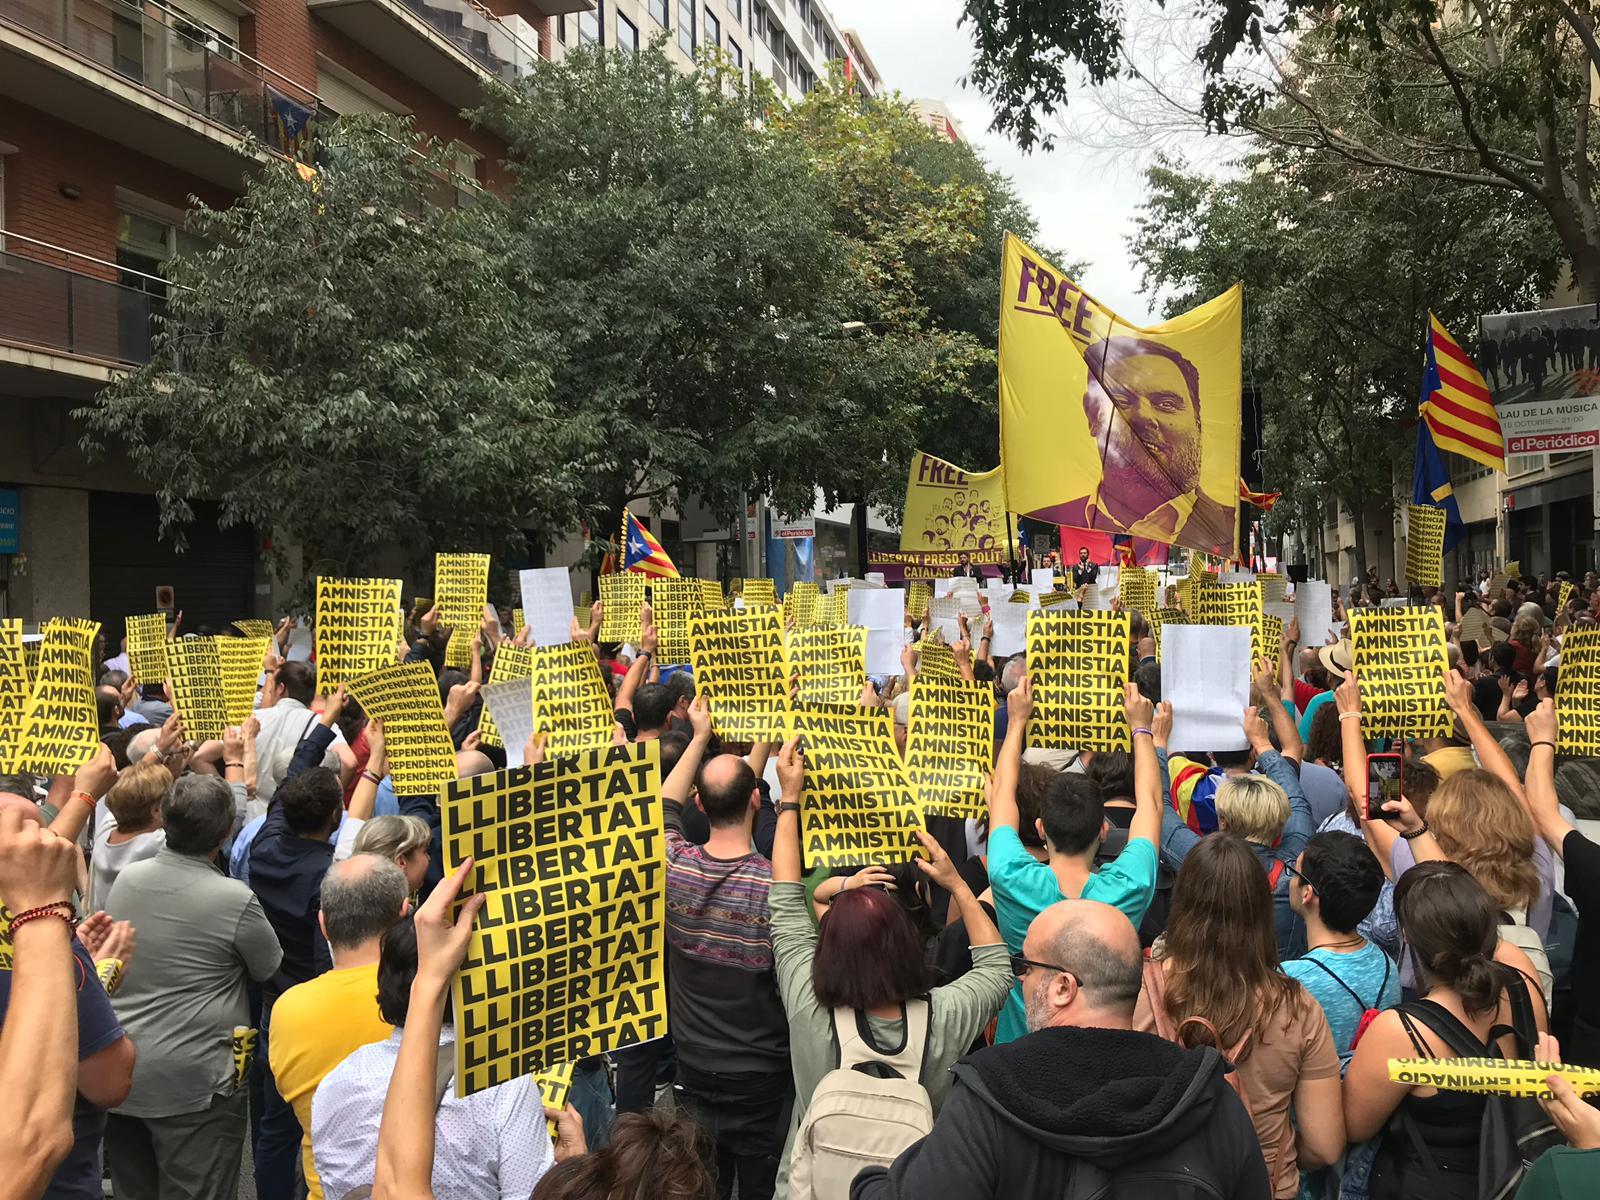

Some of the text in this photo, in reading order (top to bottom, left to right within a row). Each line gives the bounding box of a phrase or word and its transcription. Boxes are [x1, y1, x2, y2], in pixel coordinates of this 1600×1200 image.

[1017, 255, 1098, 337] FREE
[1523, 409, 1537, 417] DE
[1557, 403, 1598, 414] MÚSICA
[1514, 418, 1553, 427] OCTUBRE
[1512, 435, 1595, 451] el Periódico
[924, 554, 961, 564] PRESO
[970, 551, 1000, 563] POLÍT
[320, 587, 396, 599] AMNISTIA
[654, 584, 702, 592] LLIBERTAT
[1200, 590, 1258, 602] AMNISTIA
[654, 593, 704, 601] LLIBERTAT
[320, 601, 395, 613] AMNISTIA
[654, 603, 705, 611] LLIBERTAT
[1200, 601, 1259, 614] AMNISTIA
[319, 615, 394, 627] AMNISTIA
[691, 617, 780, 637] AMNISTIA
[1200, 614, 1259, 625] AMNISTIA
[1355, 618, 1440, 633] AMNISTIA
[319, 629, 392, 641] AMNISTIA
[1030, 622, 1126, 638] AMNISTIA
[44, 630, 90, 650] AMNISTIA
[694, 633, 782, 652] AMNISTIA
[790, 631, 862, 649] AMNISTIA
[1030, 639, 1125, 656] AMNISTIA
[1355, 634, 1442, 649] AMNISTIA
[1563, 634, 1600, 650] AMNIS
[41, 647, 89, 669] AMNISTIA
[166, 644, 217, 656] LLIBERTAT
[320, 644, 391, 655] AMNISTIA
[789, 645, 861, 662] AMNISTIA
[1355, 649, 1444, 665] AMNISTIA
[1561, 649, 1600, 666] AMNIS
[168, 655, 220, 666] LLIBERTAT
[320, 658, 390, 670] AMNISTIA
[536, 651, 594, 670] AMNISTIA
[696, 650, 783, 668] AMNISTIA
[1030, 656, 1125, 673] AMNISTIA
[170, 666, 221, 678] LLIBERTAT
[536, 666, 600, 686] AMNISTIA
[698, 666, 785, 683] AMNISTIA
[789, 660, 863, 677] AMNISTIA
[1357, 665, 1443, 681] AMNISTIA
[172, 677, 222, 688] LLIBERTAT
[349, 666, 431, 690] INDEPENDÈNCIA
[1032, 673, 1124, 689] AMNISTIA
[174, 688, 223, 699] LLIBERTAT
[355, 676, 434, 698] INDEPENDÈNCIA
[536, 681, 606, 701] AMNISTIA
[701, 682, 786, 698] AMNISTIA
[1359, 681, 1446, 697] AMNISTIA
[176, 699, 226, 710] LLIBERTAT
[361, 688, 438, 706] INDEPENDÈNCIA
[912, 687, 991, 707] AMNISTIA
[1032, 689, 1124, 707] AMNISTIA
[1361, 698, 1450, 713] AMNISTIA
[31, 704, 98, 725] AMNISTI
[368, 699, 441, 715] INDEPENDÈNCIA
[537, 697, 610, 717] AMNISTIA
[911, 705, 991, 725] AMNISTIA
[1029, 706, 1127, 724] AMNISTIA
[385, 722, 448, 733] DEPENDÈNCIA
[538, 713, 615, 733] AMNISTIA
[712, 715, 786, 729] MNISTIA
[794, 716, 890, 738] AMNISTIA
[1360, 714, 1450, 727] AMNISTIA
[26, 723, 99, 743] AMNISTI
[385, 734, 450, 746] DEPENDÈNCIA
[911, 721, 990, 742] AMNISTIA
[1030, 723, 1127, 740] AMNISTIA
[21, 741, 97, 761] AMNISTI
[385, 746, 453, 757] DEPENDÈNCIA
[797, 733, 895, 755] AMNISTIA
[910, 737, 989, 759] AMNISTIA
[388, 756, 454, 769] DEPENDÈNCIA
[447, 742, 647, 802] LLIBERTAT
[909, 771, 984, 790] AMNISTI
[802, 771, 909, 792] AMNISTIA
[449, 763, 654, 835] LLIBERTAT
[804, 790, 916, 811] AMNISTIA
[807, 809, 921, 831] AMNISTIA
[450, 796, 655, 868] LLIBERTAT
[808, 830, 923, 852] AMNISTIA
[461, 923, 660, 1006] LLIBERTAT
[464, 952, 659, 1039] LLIBERTAT
[465, 982, 659, 1070] LLIBERTAT
[465, 1014, 662, 1098] LLIBERTAT
